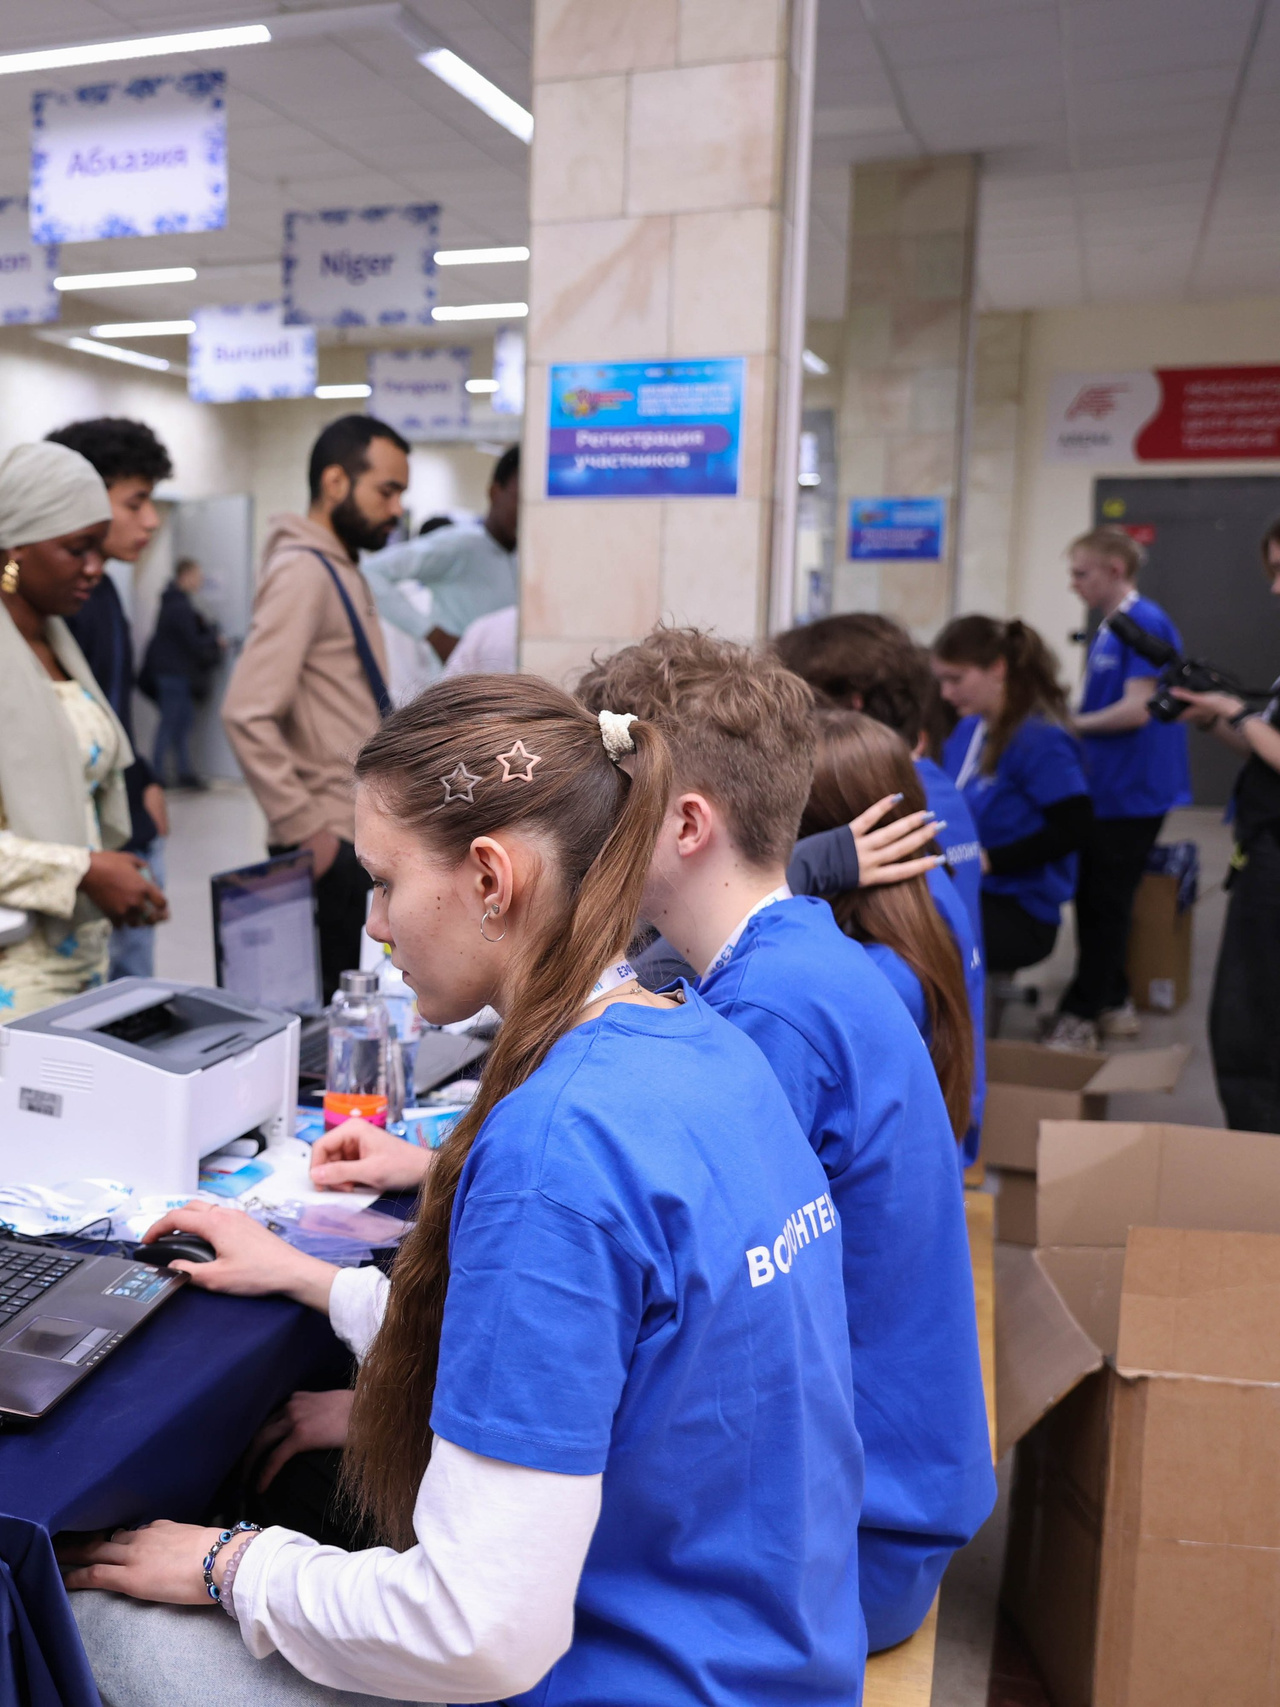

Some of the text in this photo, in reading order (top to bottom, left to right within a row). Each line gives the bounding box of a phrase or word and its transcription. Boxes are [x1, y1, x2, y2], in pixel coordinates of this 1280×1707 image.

[66, 147, 188, 179] Абхазия
[321, 248, 395, 286] Niger
[576, 429, 705, 449] Регистрация
[575, 452, 690, 473] участников
